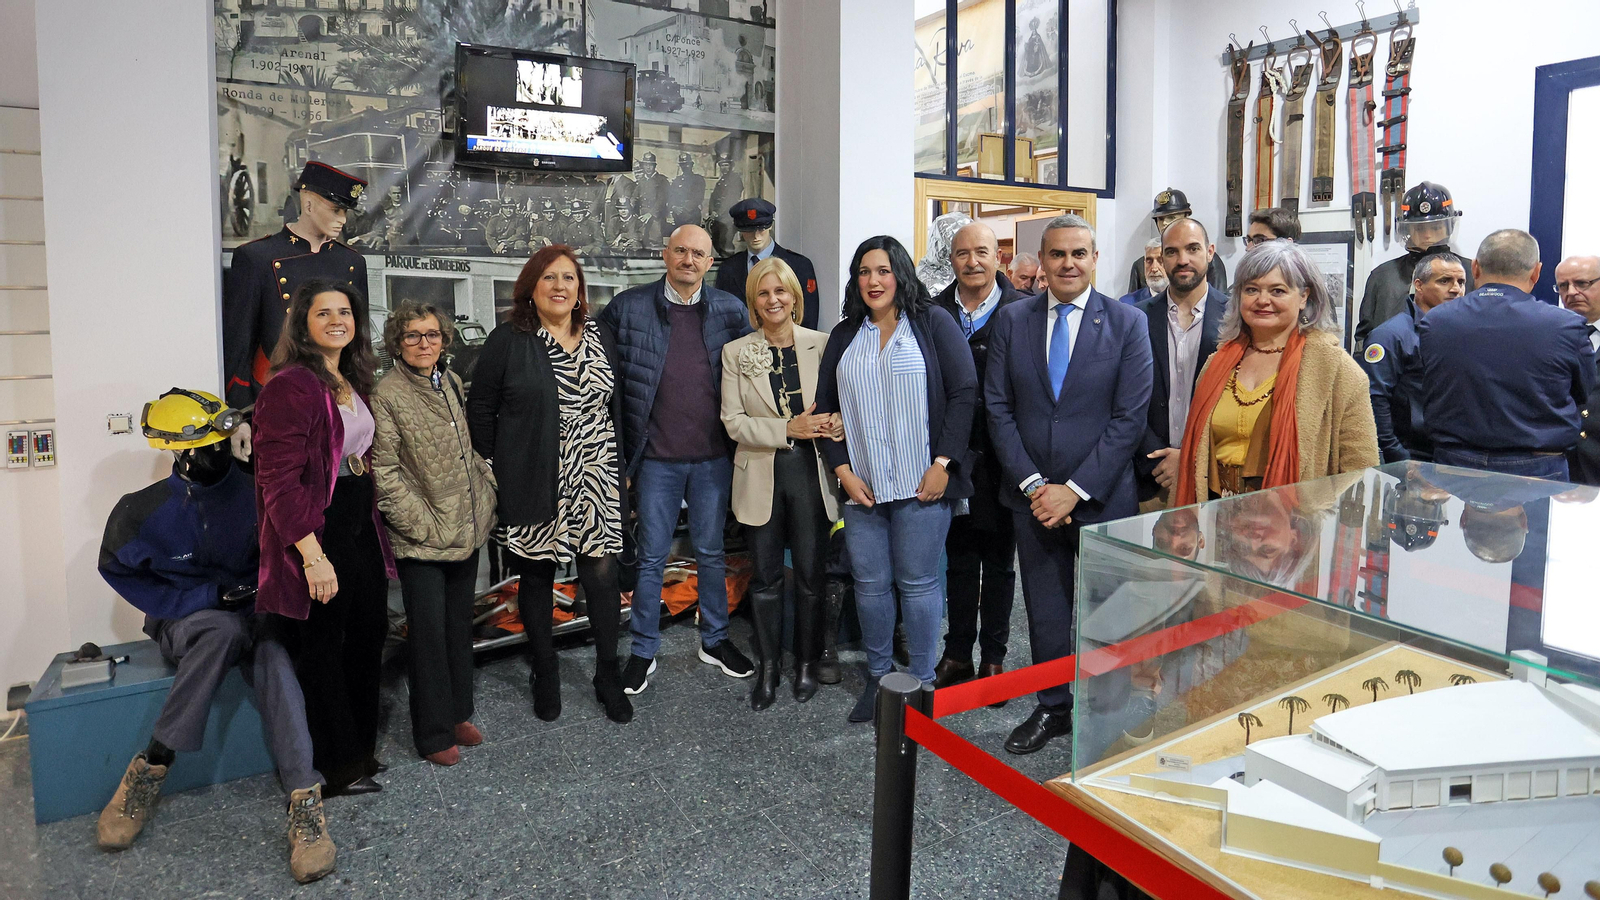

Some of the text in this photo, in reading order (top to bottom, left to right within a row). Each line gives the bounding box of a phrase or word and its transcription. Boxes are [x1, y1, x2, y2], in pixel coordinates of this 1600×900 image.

[665, 33, 701, 46] C/Ponce
[280, 47, 327, 62] Arenal
[222, 87, 263, 100] Ronda
[269, 91, 284, 102] de
[385, 255, 471, 272] PARQUE DE BOMBEROS
